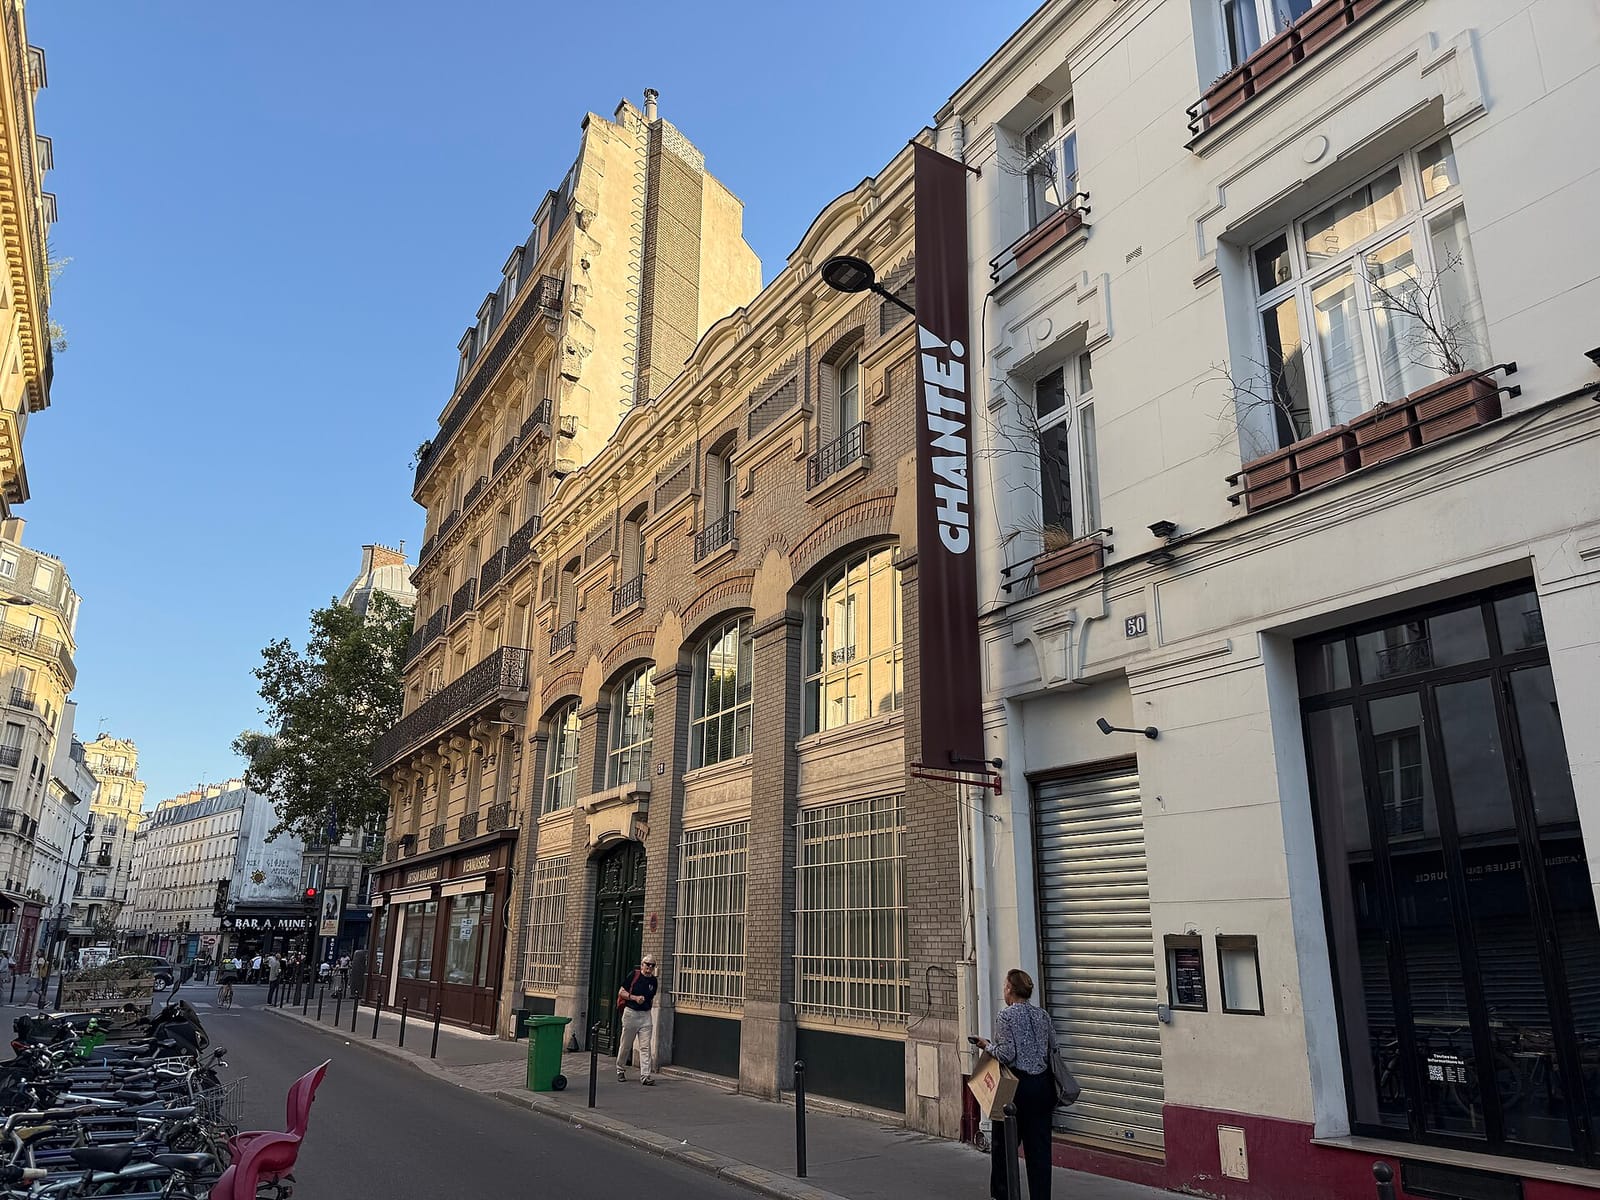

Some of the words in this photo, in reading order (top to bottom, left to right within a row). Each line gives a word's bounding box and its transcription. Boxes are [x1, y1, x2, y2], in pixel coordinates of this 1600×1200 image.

[919, 325, 970, 554] CHANTE!
[1128, 616, 1144, 635] 50
[235, 918, 258, 928] BAR
[263, 918, 272, 928] A
